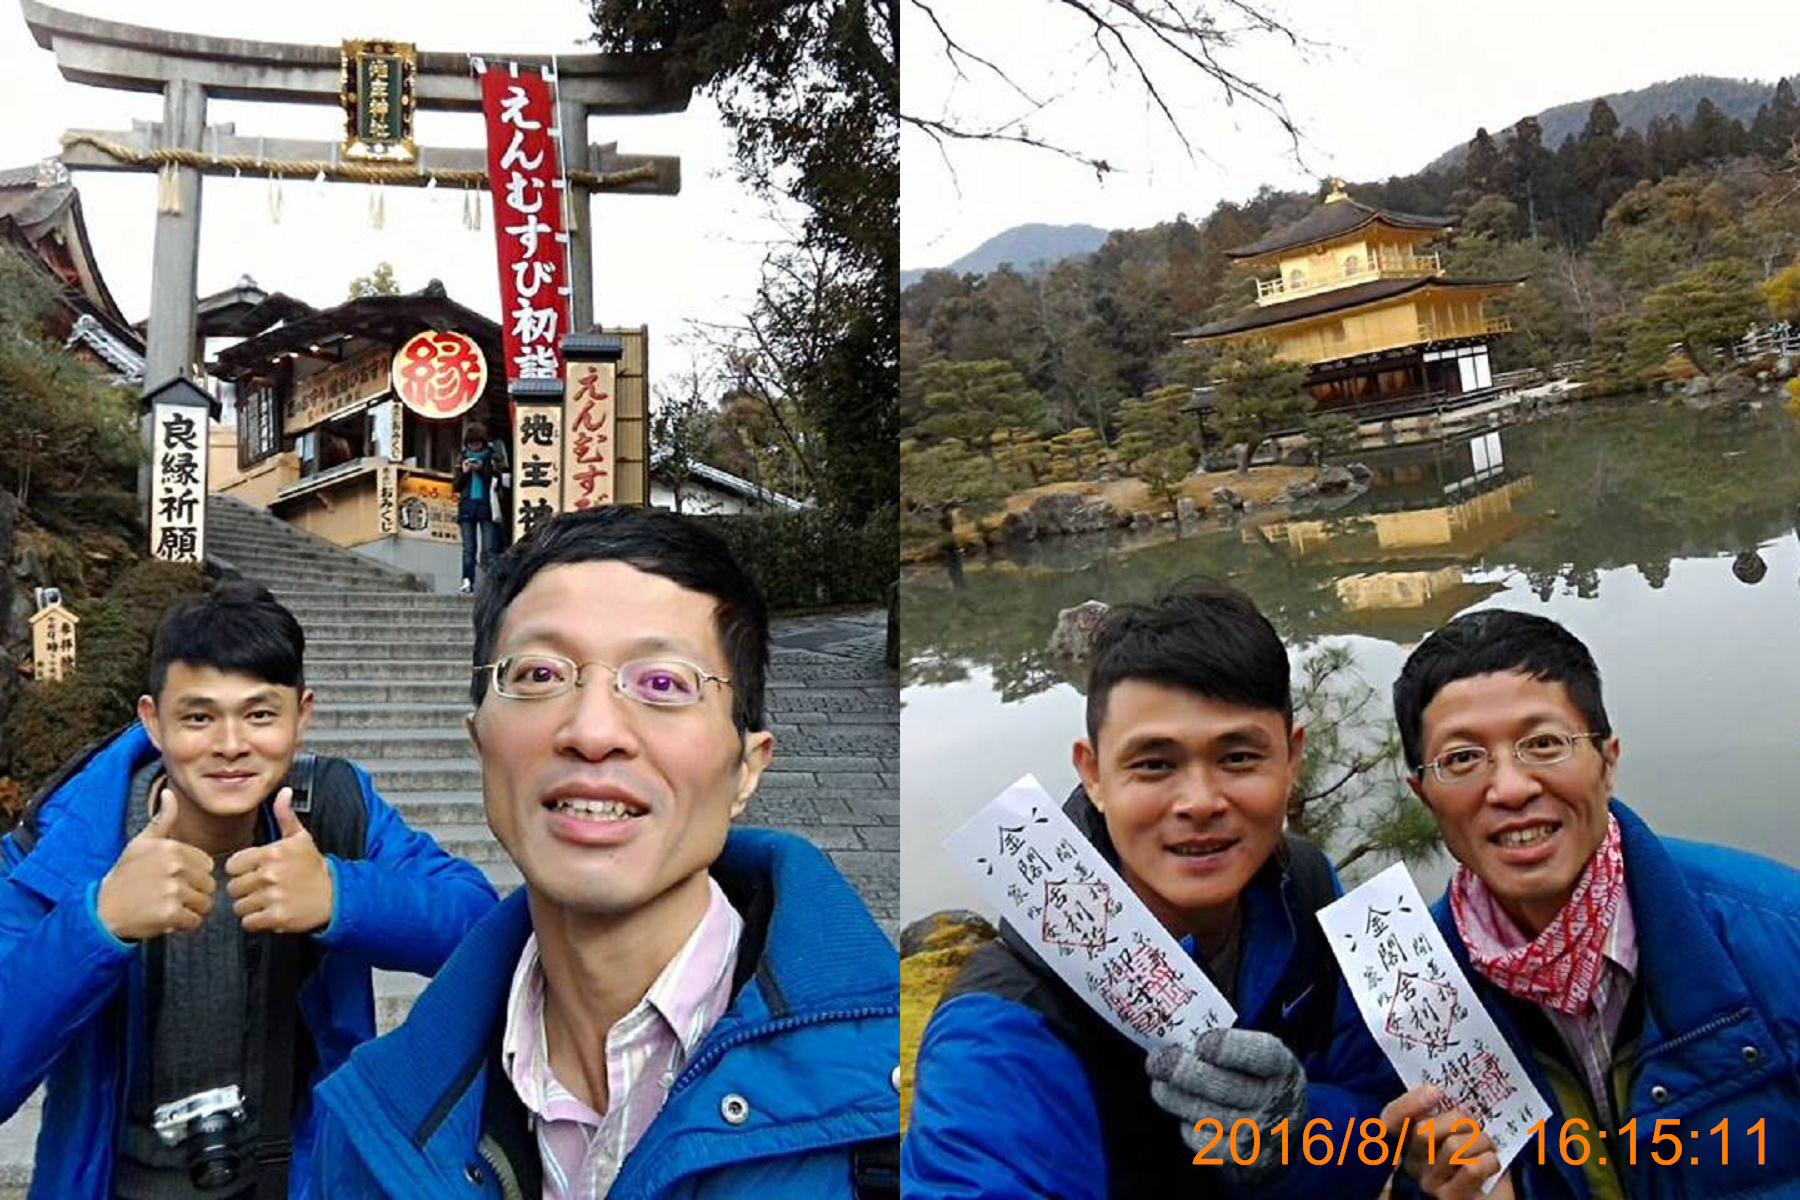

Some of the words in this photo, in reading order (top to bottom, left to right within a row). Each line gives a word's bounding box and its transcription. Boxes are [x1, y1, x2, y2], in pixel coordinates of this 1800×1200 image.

[500, 86, 559, 379] えんむすび初詣
[158, 412, 200, 561] 良縁祈願
